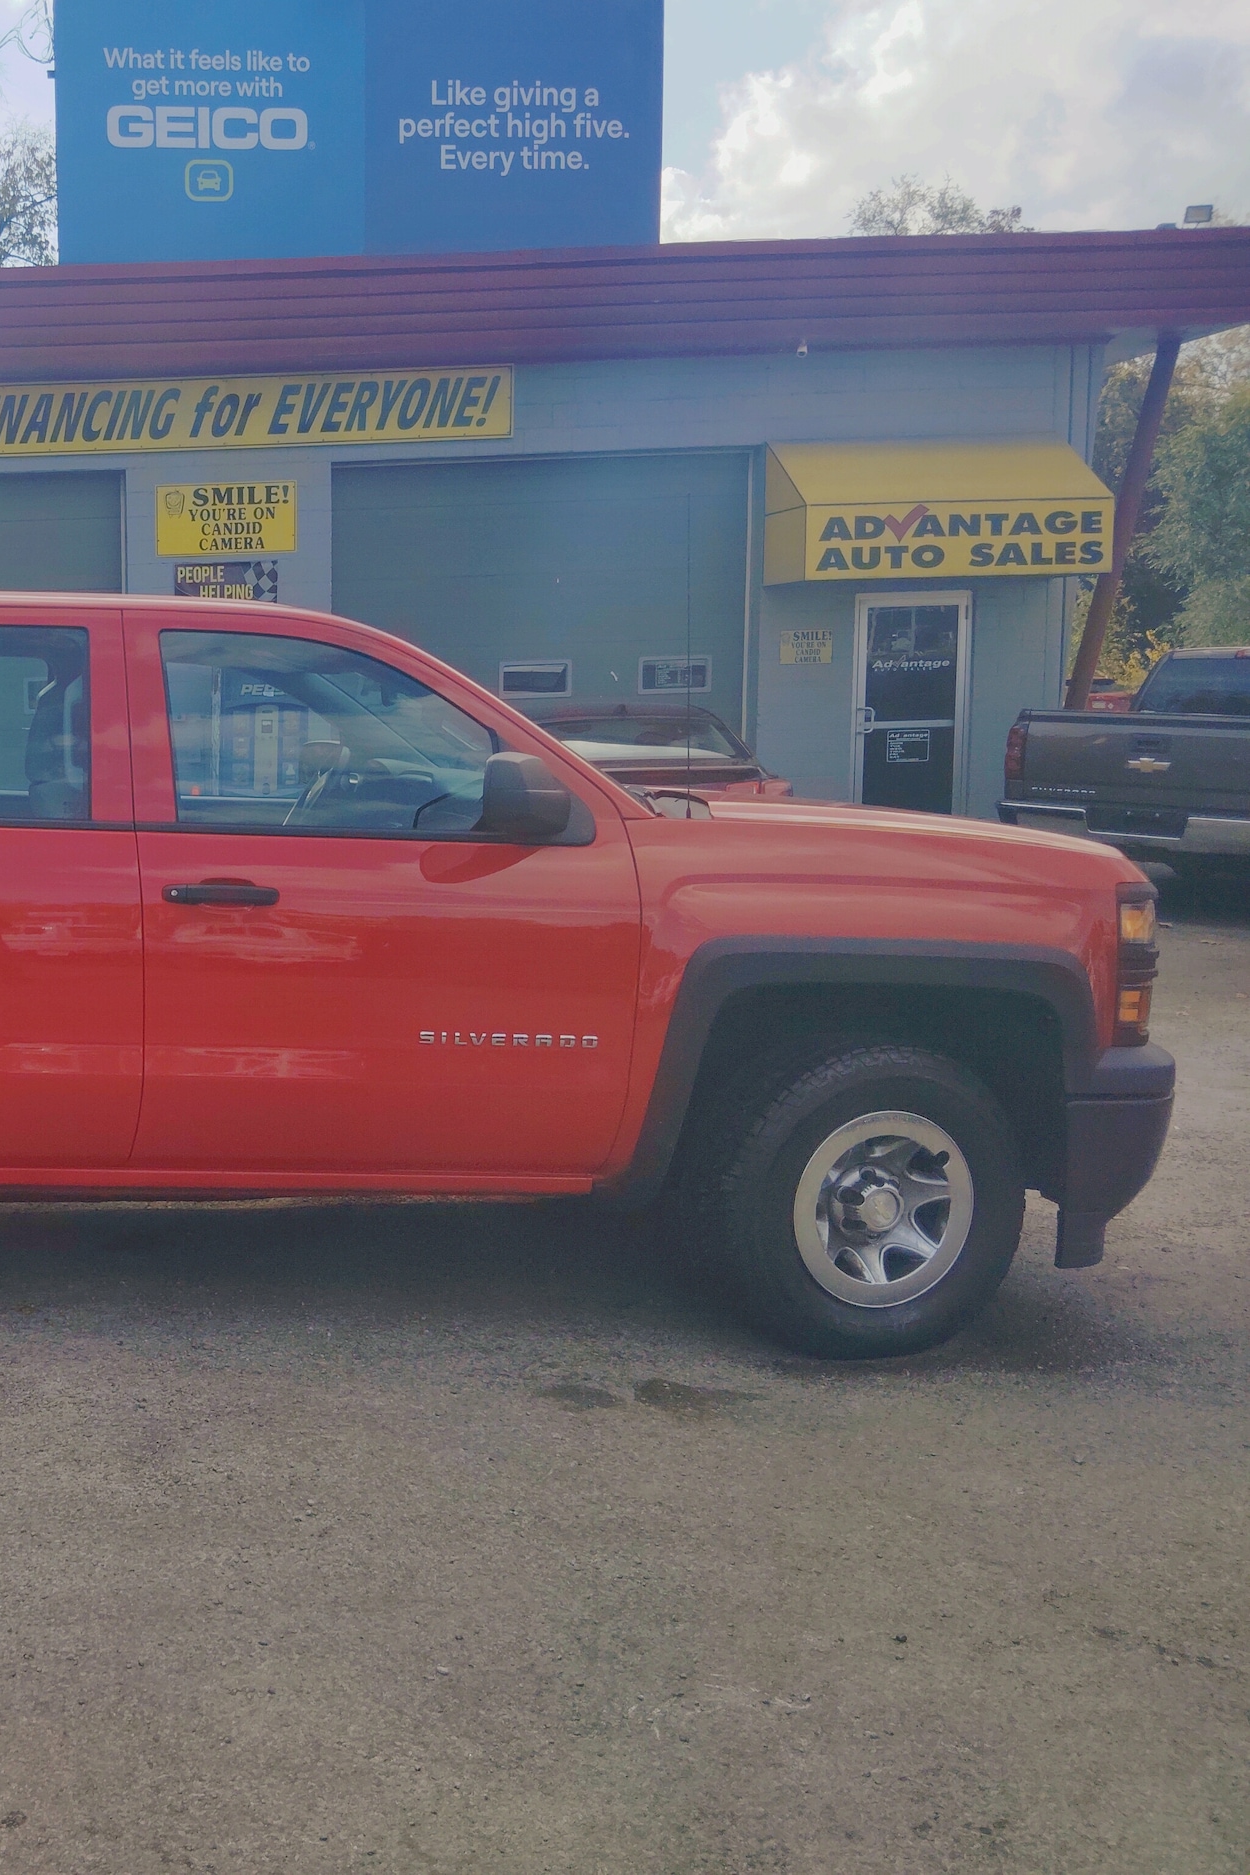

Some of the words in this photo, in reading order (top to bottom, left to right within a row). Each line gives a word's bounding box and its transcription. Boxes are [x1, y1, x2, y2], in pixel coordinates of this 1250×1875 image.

[103, 47, 165, 69] What
[170, 48, 184, 69] it
[189, 49, 241, 71] feels
[247, 50, 282, 72] like
[287, 53, 310, 72] to
[132, 76, 169, 100] get
[174, 79, 231, 97] more
[236, 76, 283, 97] with
[431, 79, 486, 106] Like
[494, 80, 576, 112] giving
[584, 87, 599, 107] a
[107, 105, 308, 150] GEICO
[399, 112, 499, 144] perfect
[507, 112, 566, 144] high
[573, 112, 630, 139] five.
[440, 144, 515, 177] Every
[520, 144, 590, 170] time.
[188, 385, 262, 438] for
[267, 375, 501, 435] EVERYONE!
[192, 485, 289, 507] SMILE!
[188, 507, 247, 522] YOU'RE
[253, 506, 276, 520] ON
[818, 504, 1104, 543] ADVANTAGE
[201, 521, 263, 536] CANDID
[199, 536, 265, 551] CAMERA
[815, 545, 945, 572] AUTO
[968, 541, 1104, 567] SALES
[177, 565, 225, 584] PEOPLE
[793, 631, 832, 642] SMILE!
[418, 1030, 599, 1049] SILVERADO
